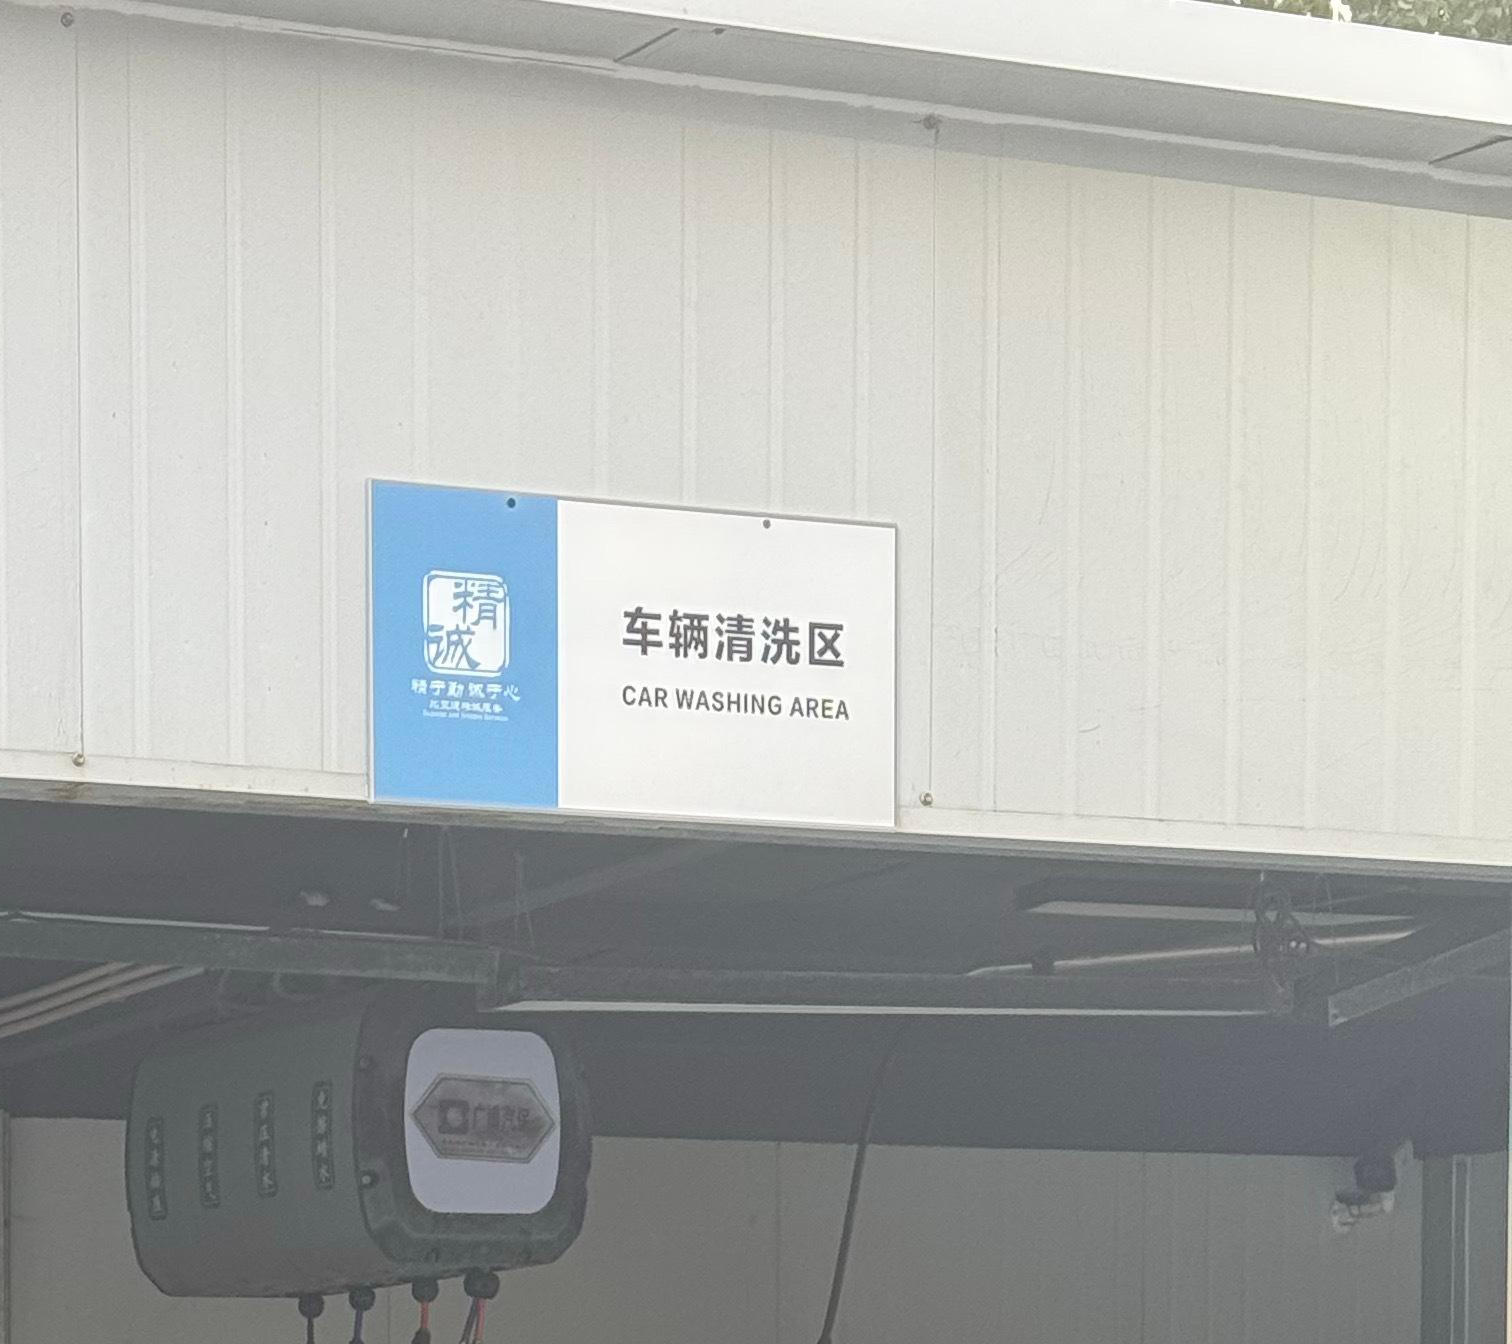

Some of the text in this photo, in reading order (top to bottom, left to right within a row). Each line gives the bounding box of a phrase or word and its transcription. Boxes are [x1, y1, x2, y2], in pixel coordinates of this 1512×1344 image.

[622, 606, 845, 668] 车辆清洗区
[622, 685, 850, 721] CAR WASHING AREA
